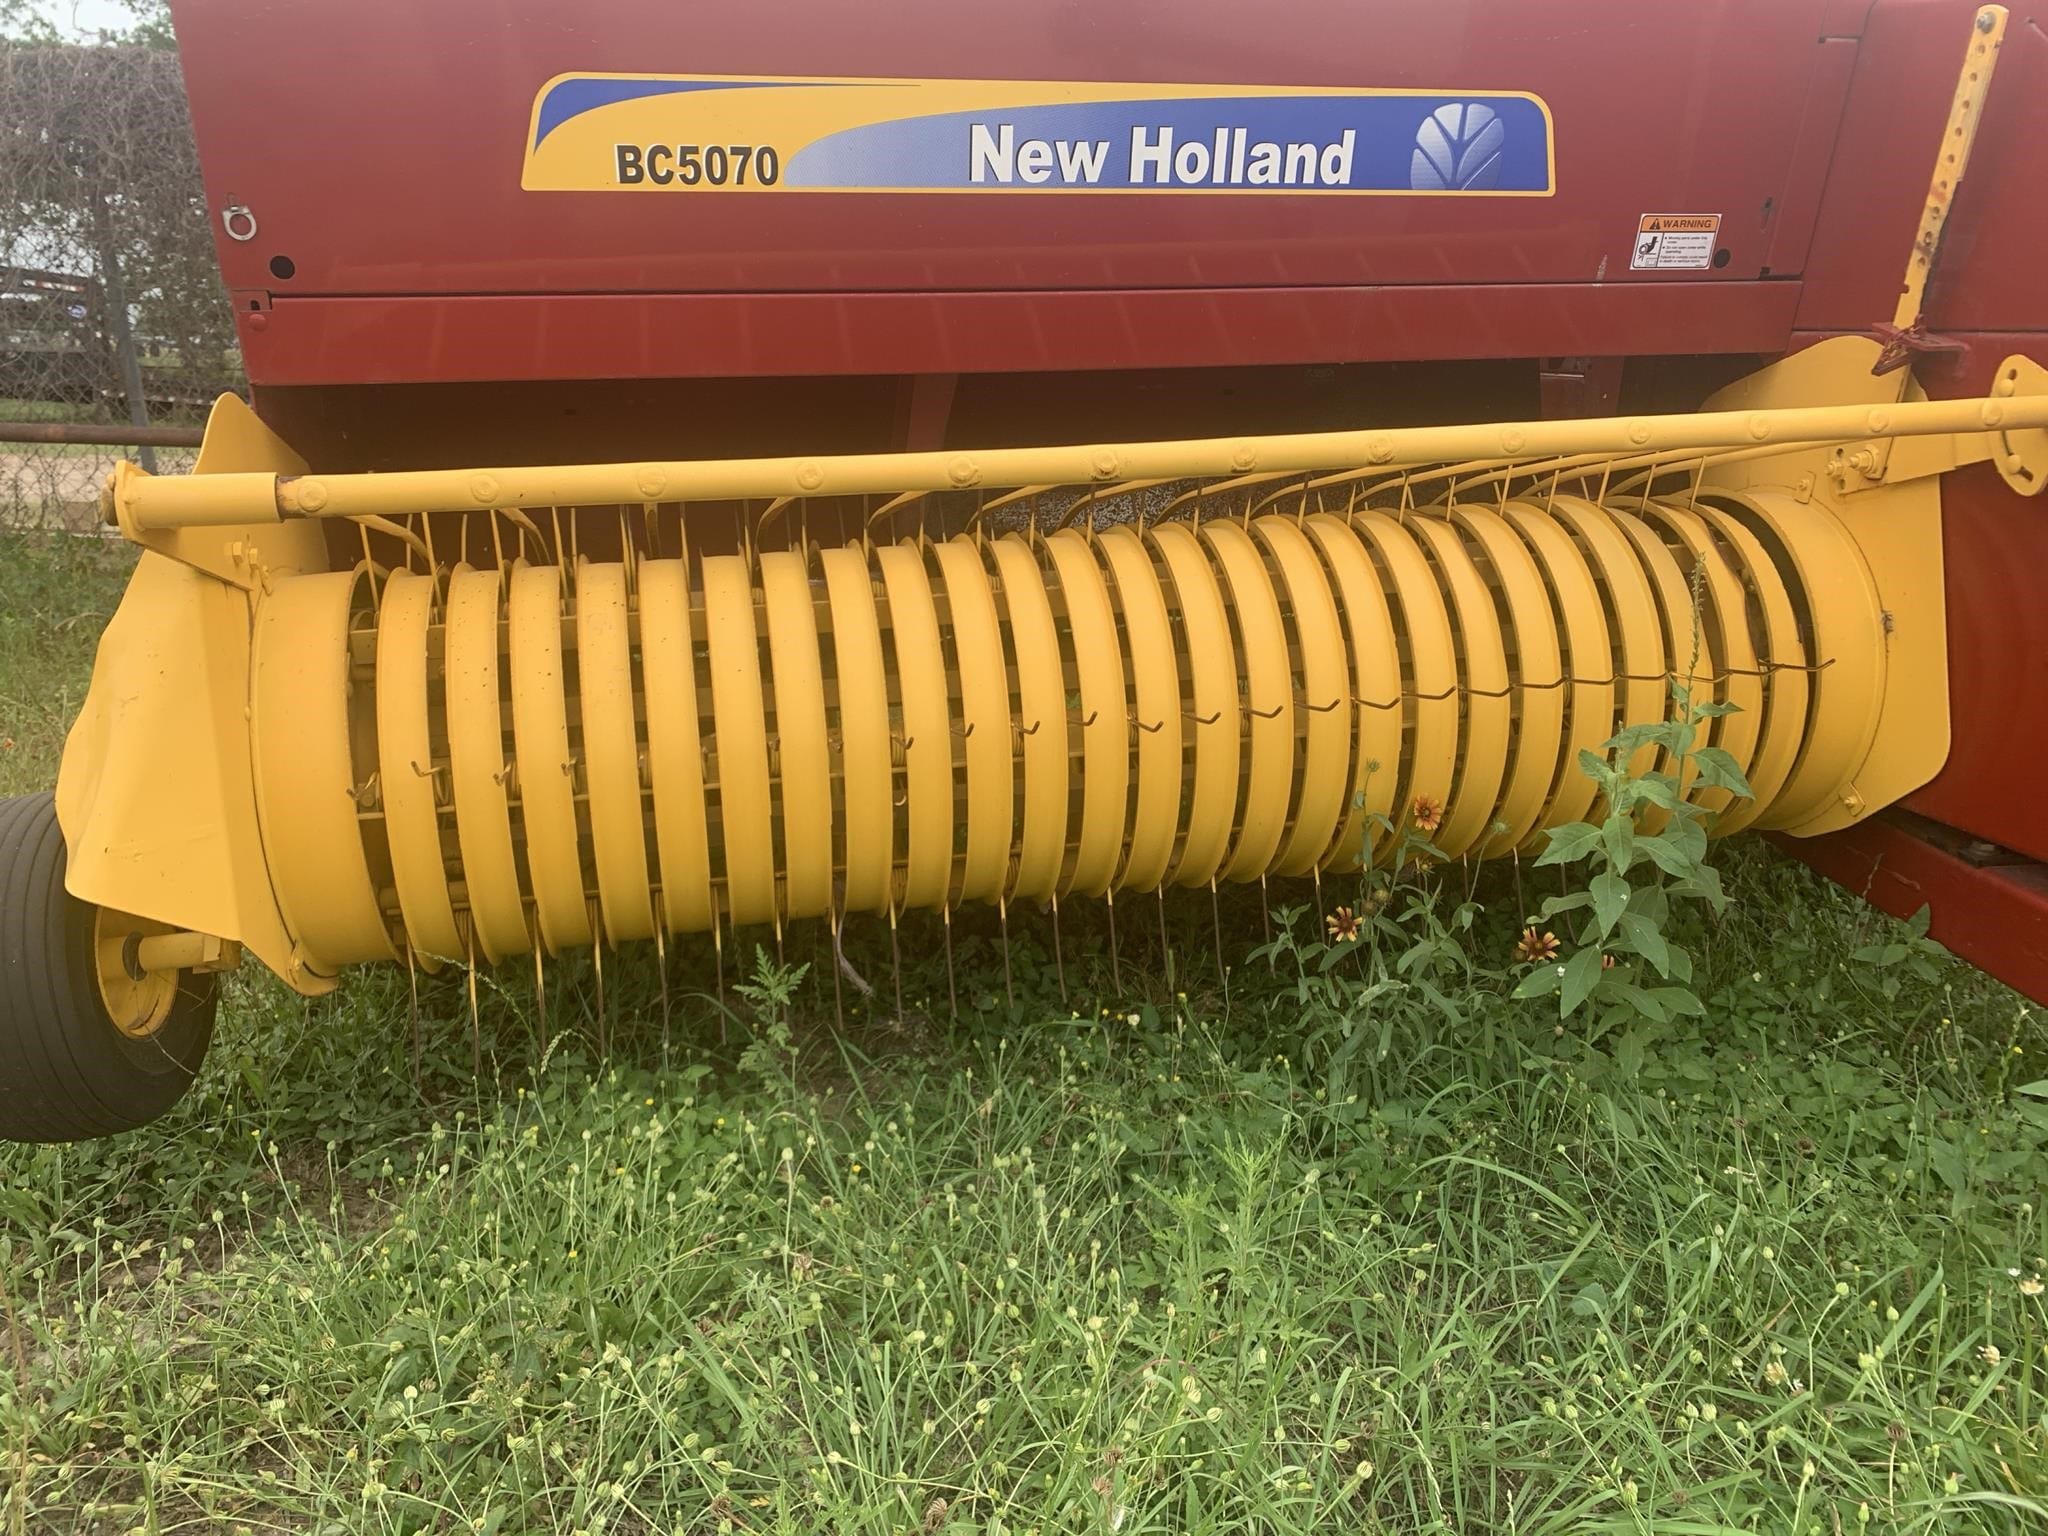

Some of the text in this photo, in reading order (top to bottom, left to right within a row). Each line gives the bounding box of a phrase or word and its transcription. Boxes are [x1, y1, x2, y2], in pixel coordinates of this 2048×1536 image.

[615, 144, 779, 185] BC5070
[969, 124, 1356, 186] New Holland
[1663, 218, 1712, 229] WARNING
